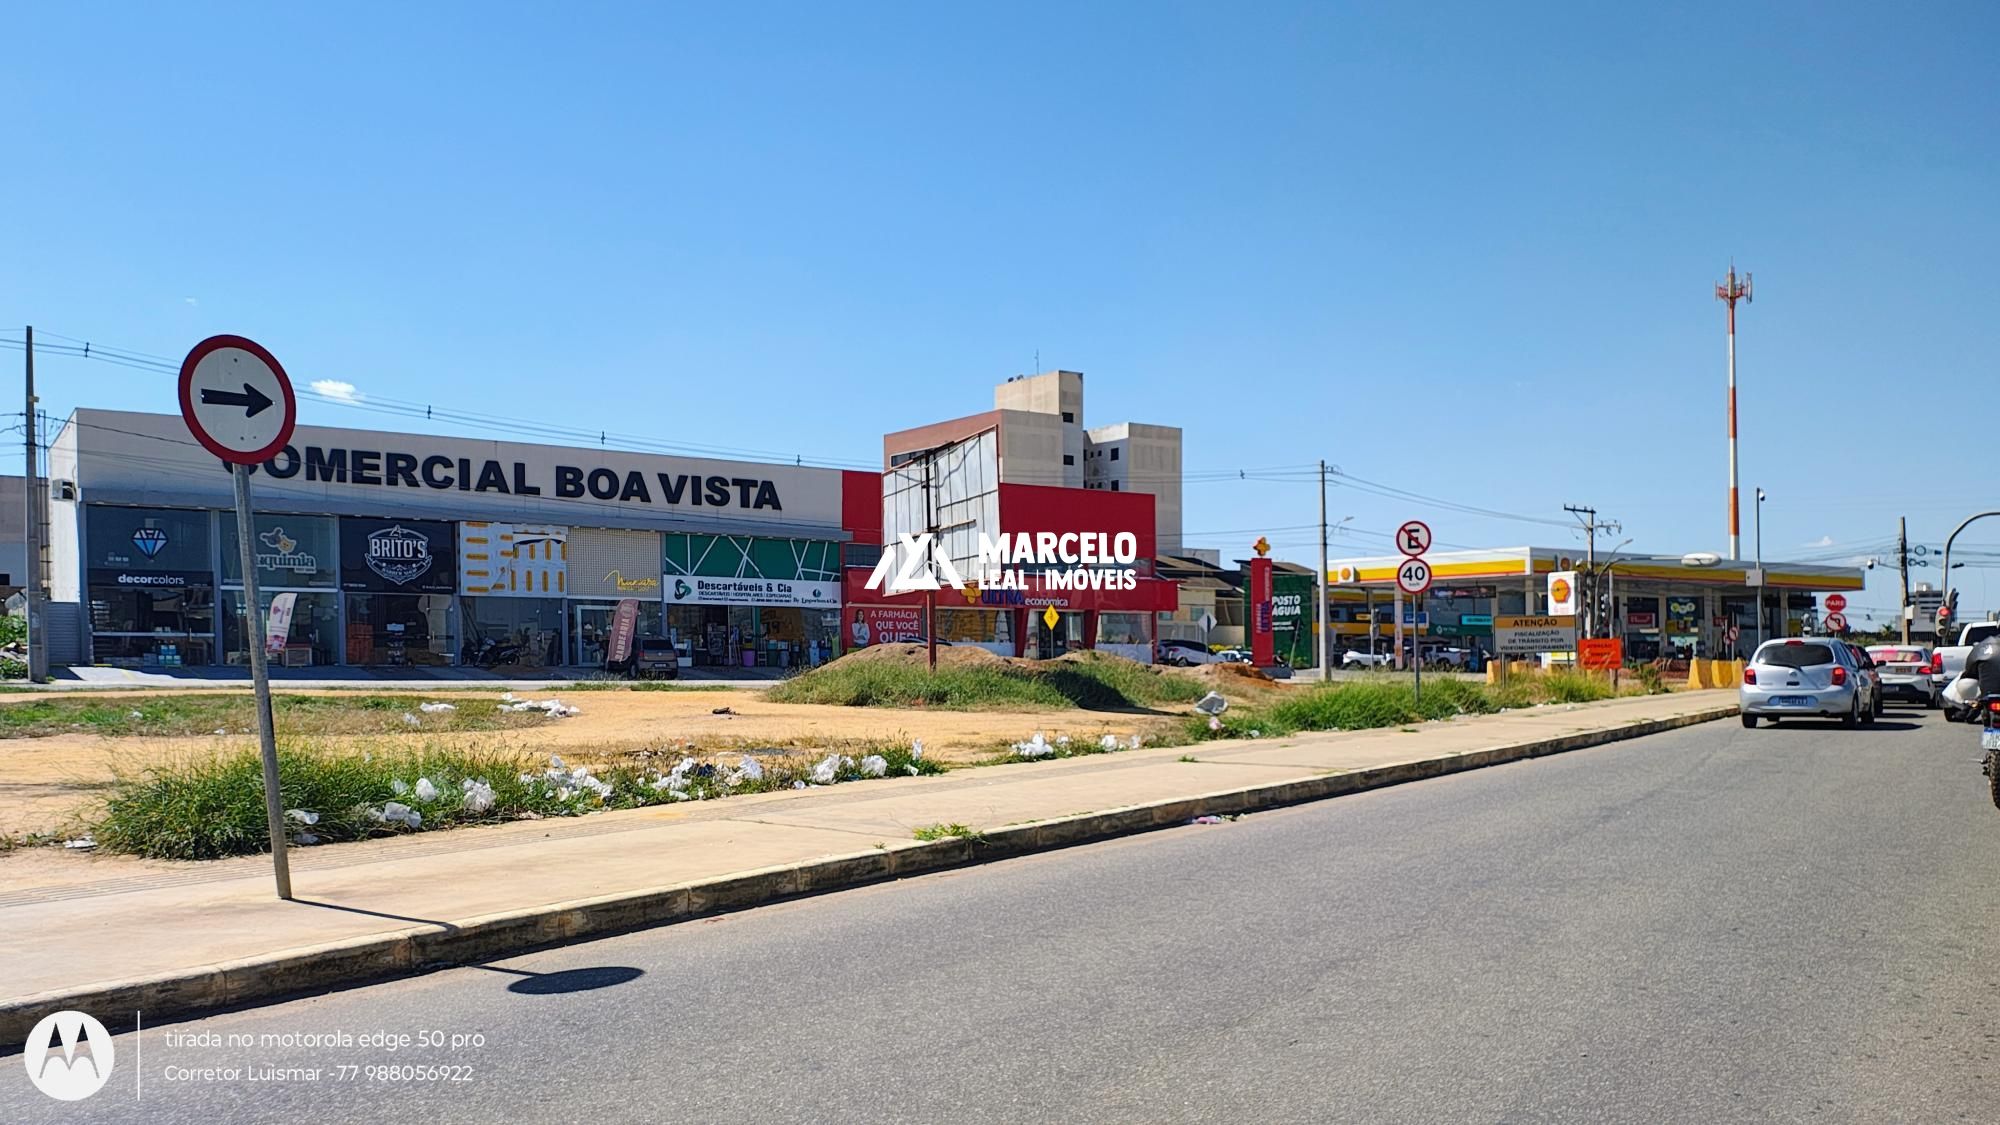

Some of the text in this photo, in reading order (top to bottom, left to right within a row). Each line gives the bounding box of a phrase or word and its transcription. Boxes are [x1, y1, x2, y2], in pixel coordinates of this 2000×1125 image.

[556, 465, 651, 503] BOA
[658, 472, 782, 511] VISTA
[371, 538, 426, 559] BRITO'S
[117, 573, 185, 585] decorcolors
[1402, 566, 1426, 582] 40
[697, 580, 792, 593] Descartáveis & Cia
[1271, 595, 1301, 606] POSTO
[1826, 599, 1844, 607] PARE
[870, 609, 918, 619] A FARMÁCIA
[1271, 604, 1301, 616] ÁGUIA
[876, 620, 919, 631] QUE VOCÊ
[1513, 618, 1557, 627] ATENÇÃO
[1514, 629, 1560, 637] FISCALIZAÇÃO
[614, 618, 631, 660] BARBEARIA
[1500, 643, 1573, 651] VIDEOMONITORAMENTO
